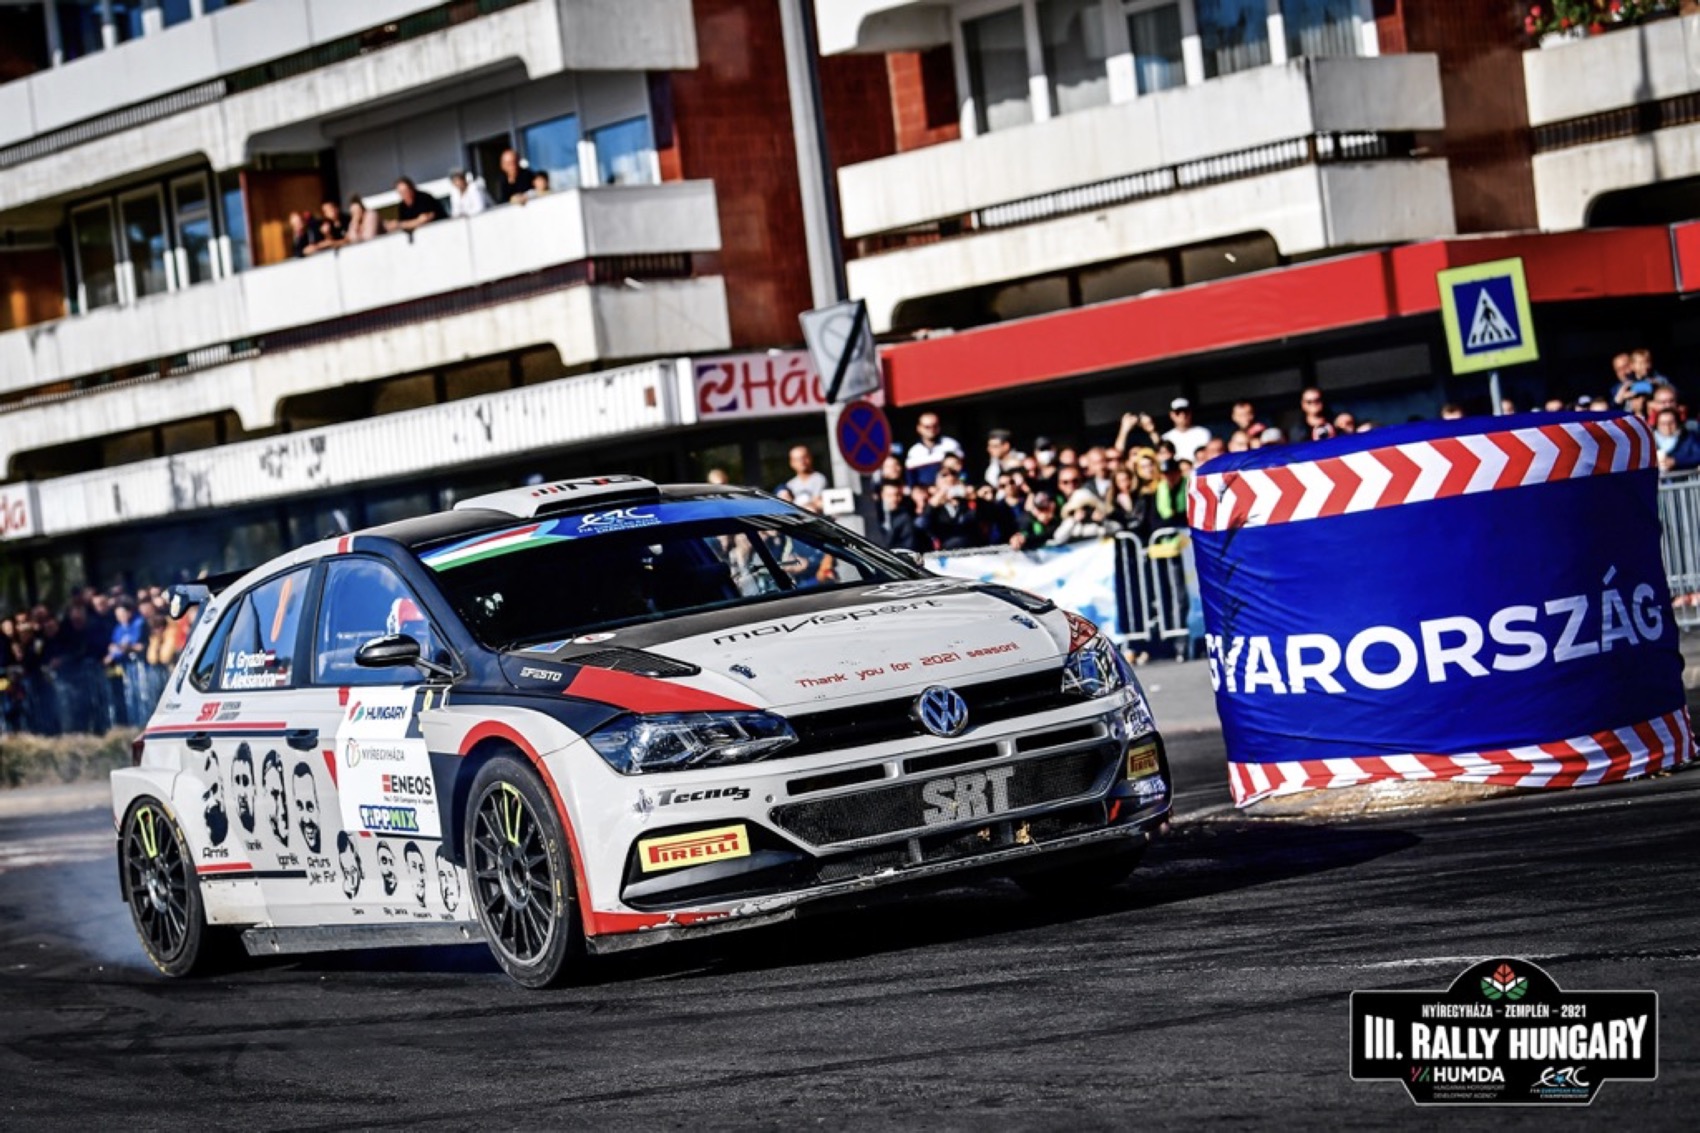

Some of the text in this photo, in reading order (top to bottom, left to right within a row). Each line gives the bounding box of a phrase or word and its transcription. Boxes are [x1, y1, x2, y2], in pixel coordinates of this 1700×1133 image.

[795, 641, 1020, 688] Thank you for 2021 season!
[365, 705, 407, 720] HUNGARY
[391, 775, 432, 795] ENEOS
[922, 765, 1014, 826] SRT
[202, 846, 229, 858] Arnis
[648, 832, 740, 865] PIRELLI
